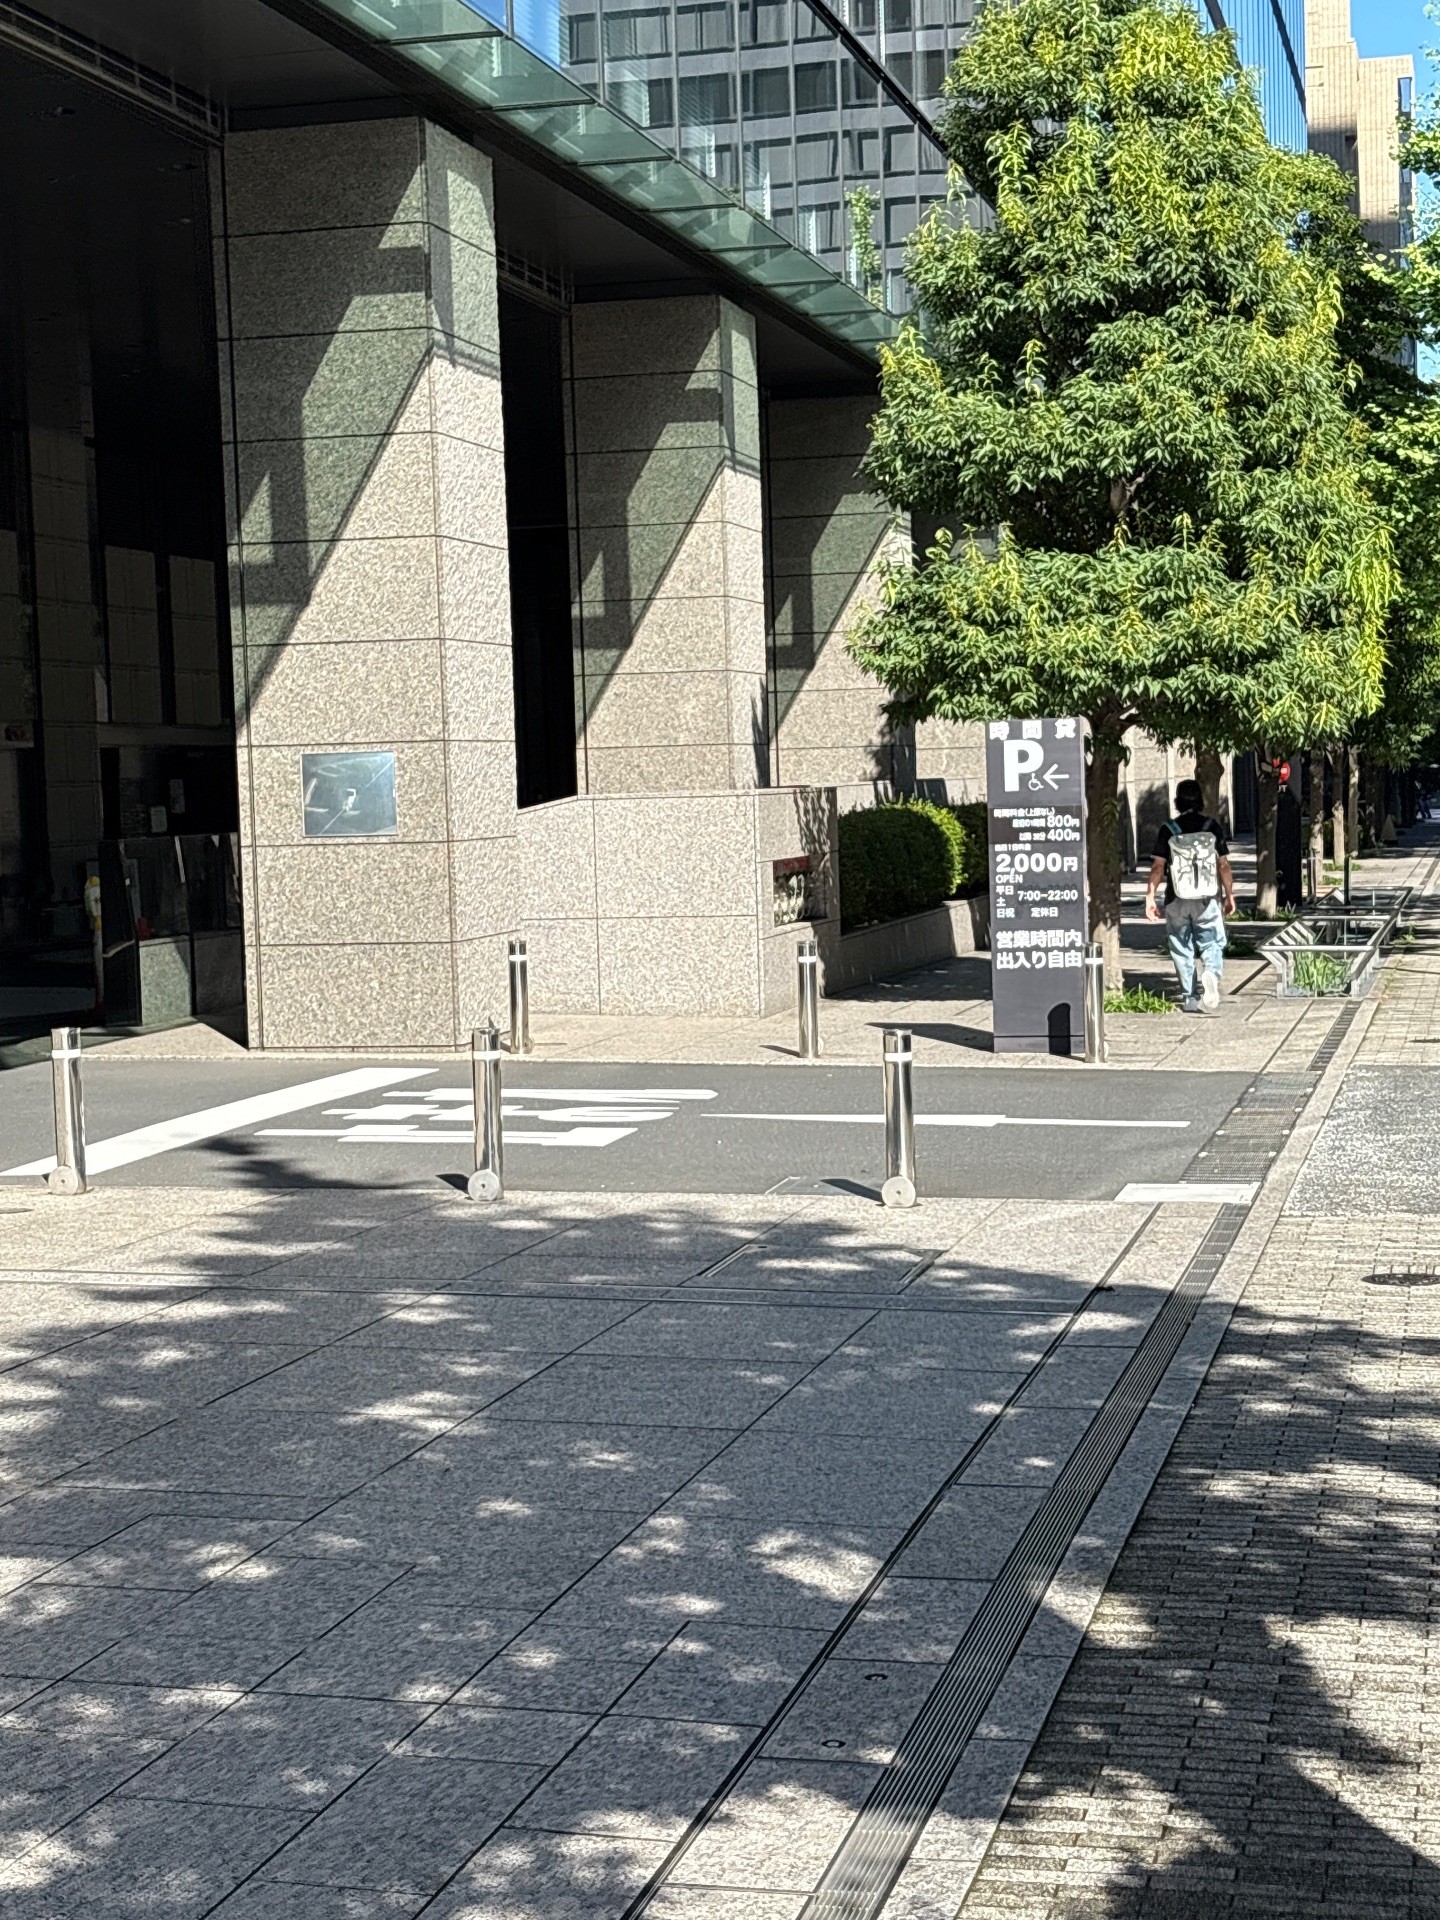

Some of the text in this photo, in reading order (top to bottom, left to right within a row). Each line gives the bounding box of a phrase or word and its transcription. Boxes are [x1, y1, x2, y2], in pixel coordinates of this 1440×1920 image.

[1003, 739, 1044, 792] P
[1047, 814, 1080, 828] 800円
[1047, 828, 1080, 841] 400円
[995, 852, 1078, 876] 2,000円
[995, 874, 1023, 884] OPEN
[996, 885, 1014, 896] 平日
[996, 896, 1007, 907] 土
[996, 906, 1059, 918] 日祝 定休日
[996, 929, 1082, 949] 営業時間内
[996, 949, 1082, 969] 出入り自由
